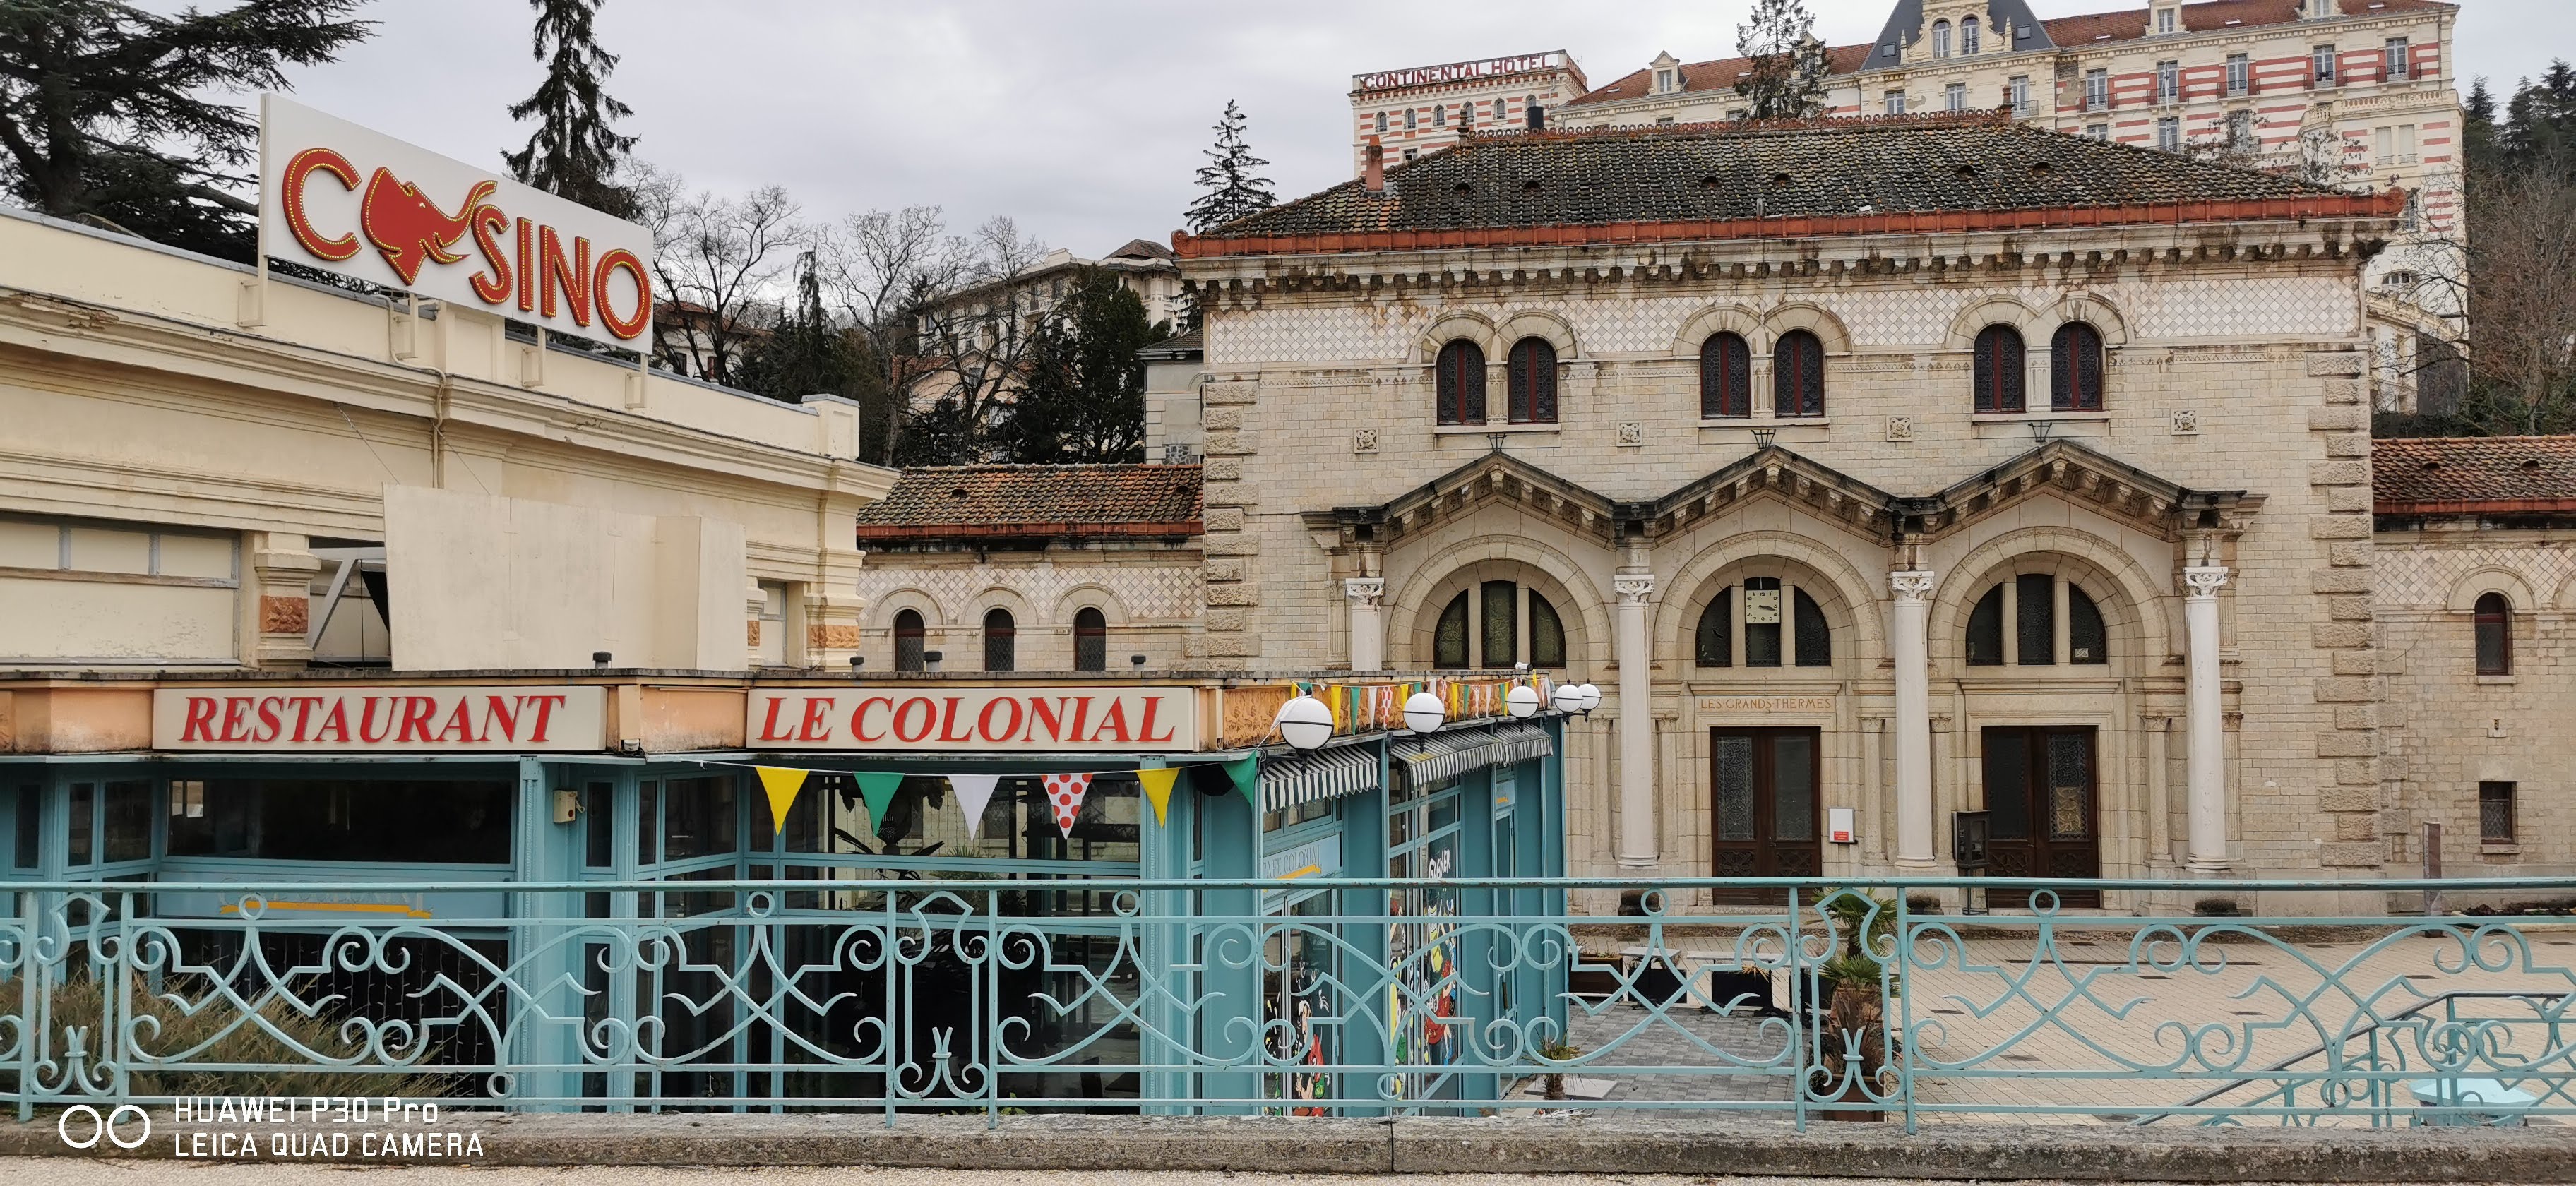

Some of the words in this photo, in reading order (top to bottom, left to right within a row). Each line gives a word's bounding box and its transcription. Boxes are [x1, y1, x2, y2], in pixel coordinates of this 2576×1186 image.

[1364, 61, 1481, 90] CONTINENTAL
[1491, 54, 1554, 73] HOTEL
[282, 147, 652, 340] CSINO
[181, 695, 566, 743] RESTAURANT
[757, 696, 836, 742] LE
[850, 696, 1176, 743] COLONIAL
[1700, 698, 1723, 709] LES
[1725, 698, 1772, 709] GRANDS
[1775, 698, 1832, 709] THERMES
